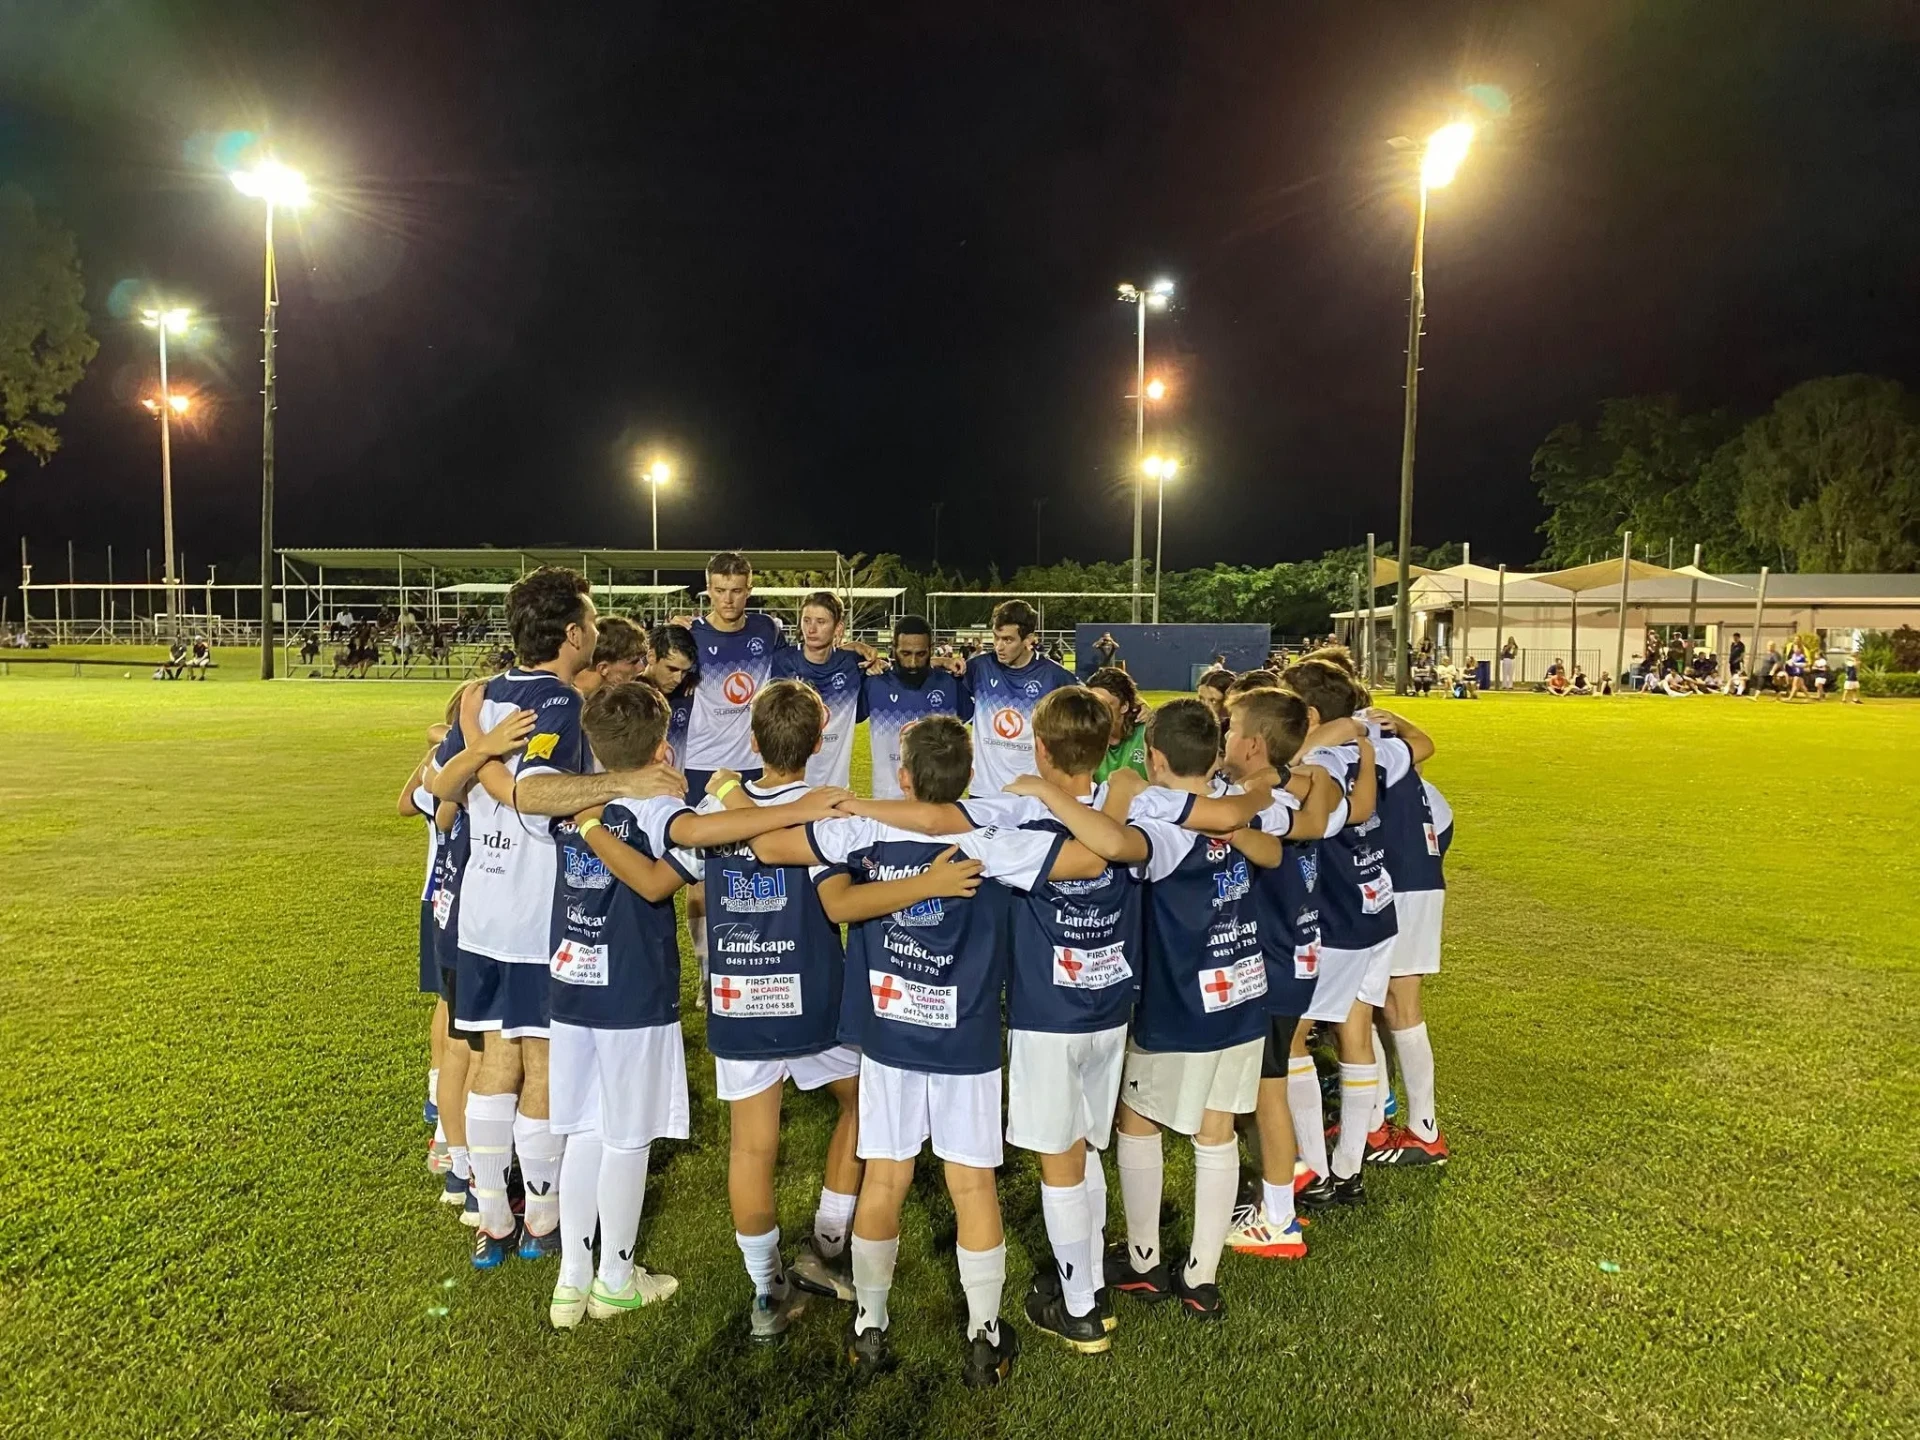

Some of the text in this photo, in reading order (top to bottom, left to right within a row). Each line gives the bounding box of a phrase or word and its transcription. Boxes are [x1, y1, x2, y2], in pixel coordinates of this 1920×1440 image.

[1063, 930, 1085, 940] 0481
[717, 938, 796, 954] Landscape
[1086, 949, 1108, 959] FIRST
[725, 956, 781, 966] 0481 113 793
[907, 961, 922, 972] 113
[924, 965, 940, 977] 793
[745, 976, 795, 986] FIRST AIDE
[928, 988, 952, 996] AIDE
[751, 994, 790, 1002] SMITHFIELD
[916, 995, 946, 1004] CAIRNS
[745, 1003, 764, 1011] 0412
[765, 1002, 779, 1010] 046
[935, 1012, 949, 1020] 588
